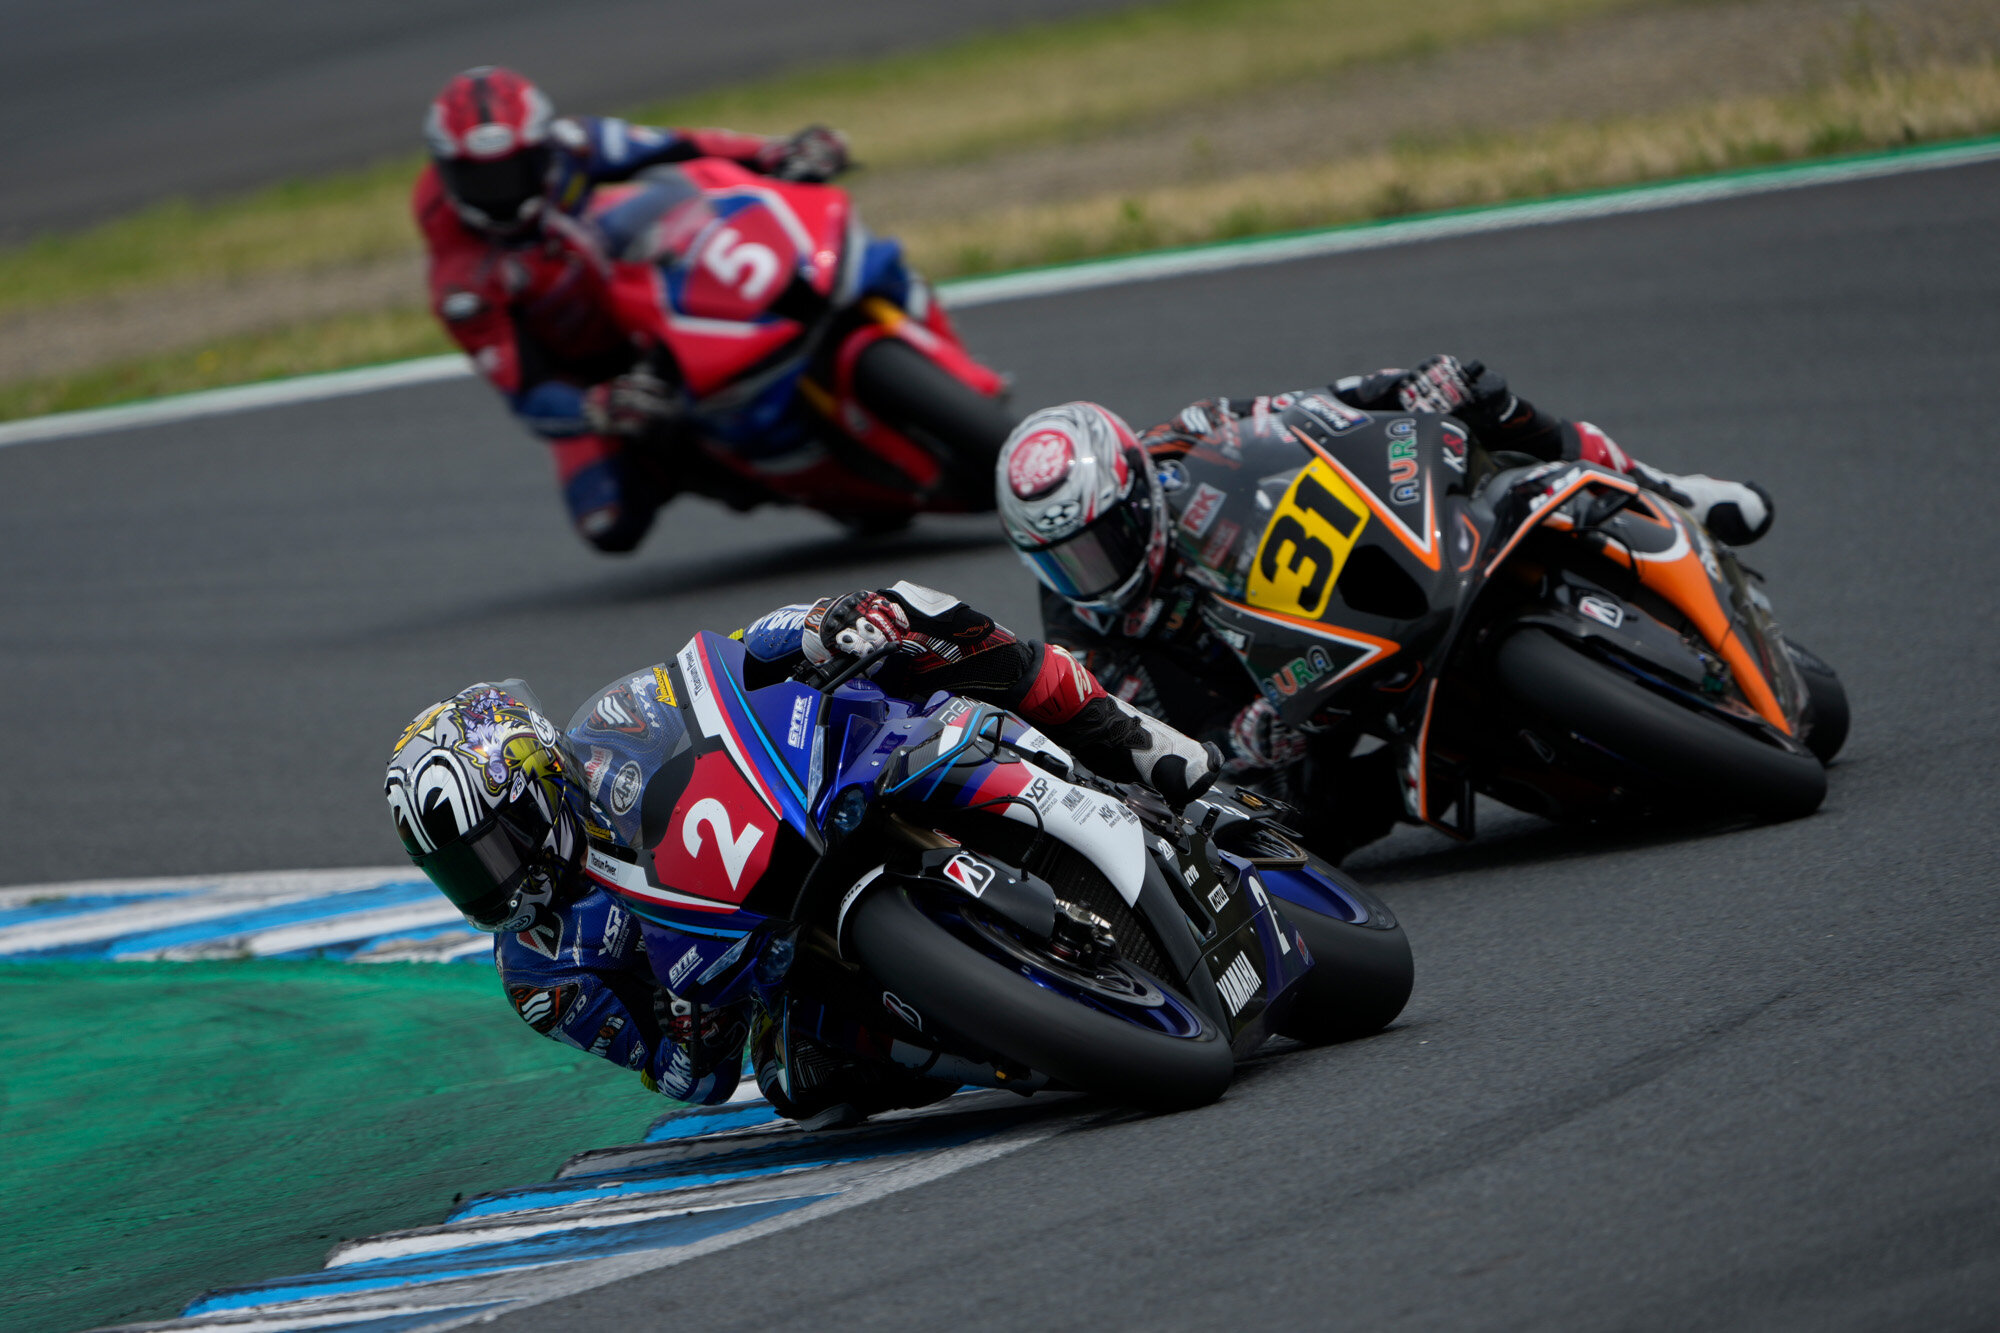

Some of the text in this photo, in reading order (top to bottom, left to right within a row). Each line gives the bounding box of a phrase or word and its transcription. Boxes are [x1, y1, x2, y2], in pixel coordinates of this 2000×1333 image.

[705, 228, 779, 299] 5
[1385, 418, 1421, 506] AURA
[1182, 488, 1220, 531] RK
[1260, 473, 1361, 613] 31
[1261, 644, 1334, 704] AURA
[1026, 777, 1049, 804] YSP
[1098, 804, 1117, 823] NGK
[682, 798, 764, 891] 2
[1184, 864, 1200, 887] KYB
[597, 904, 626, 957] YSP
[1249, 876, 1291, 955] 2
[1216, 950, 1262, 1018] YAMAHA
